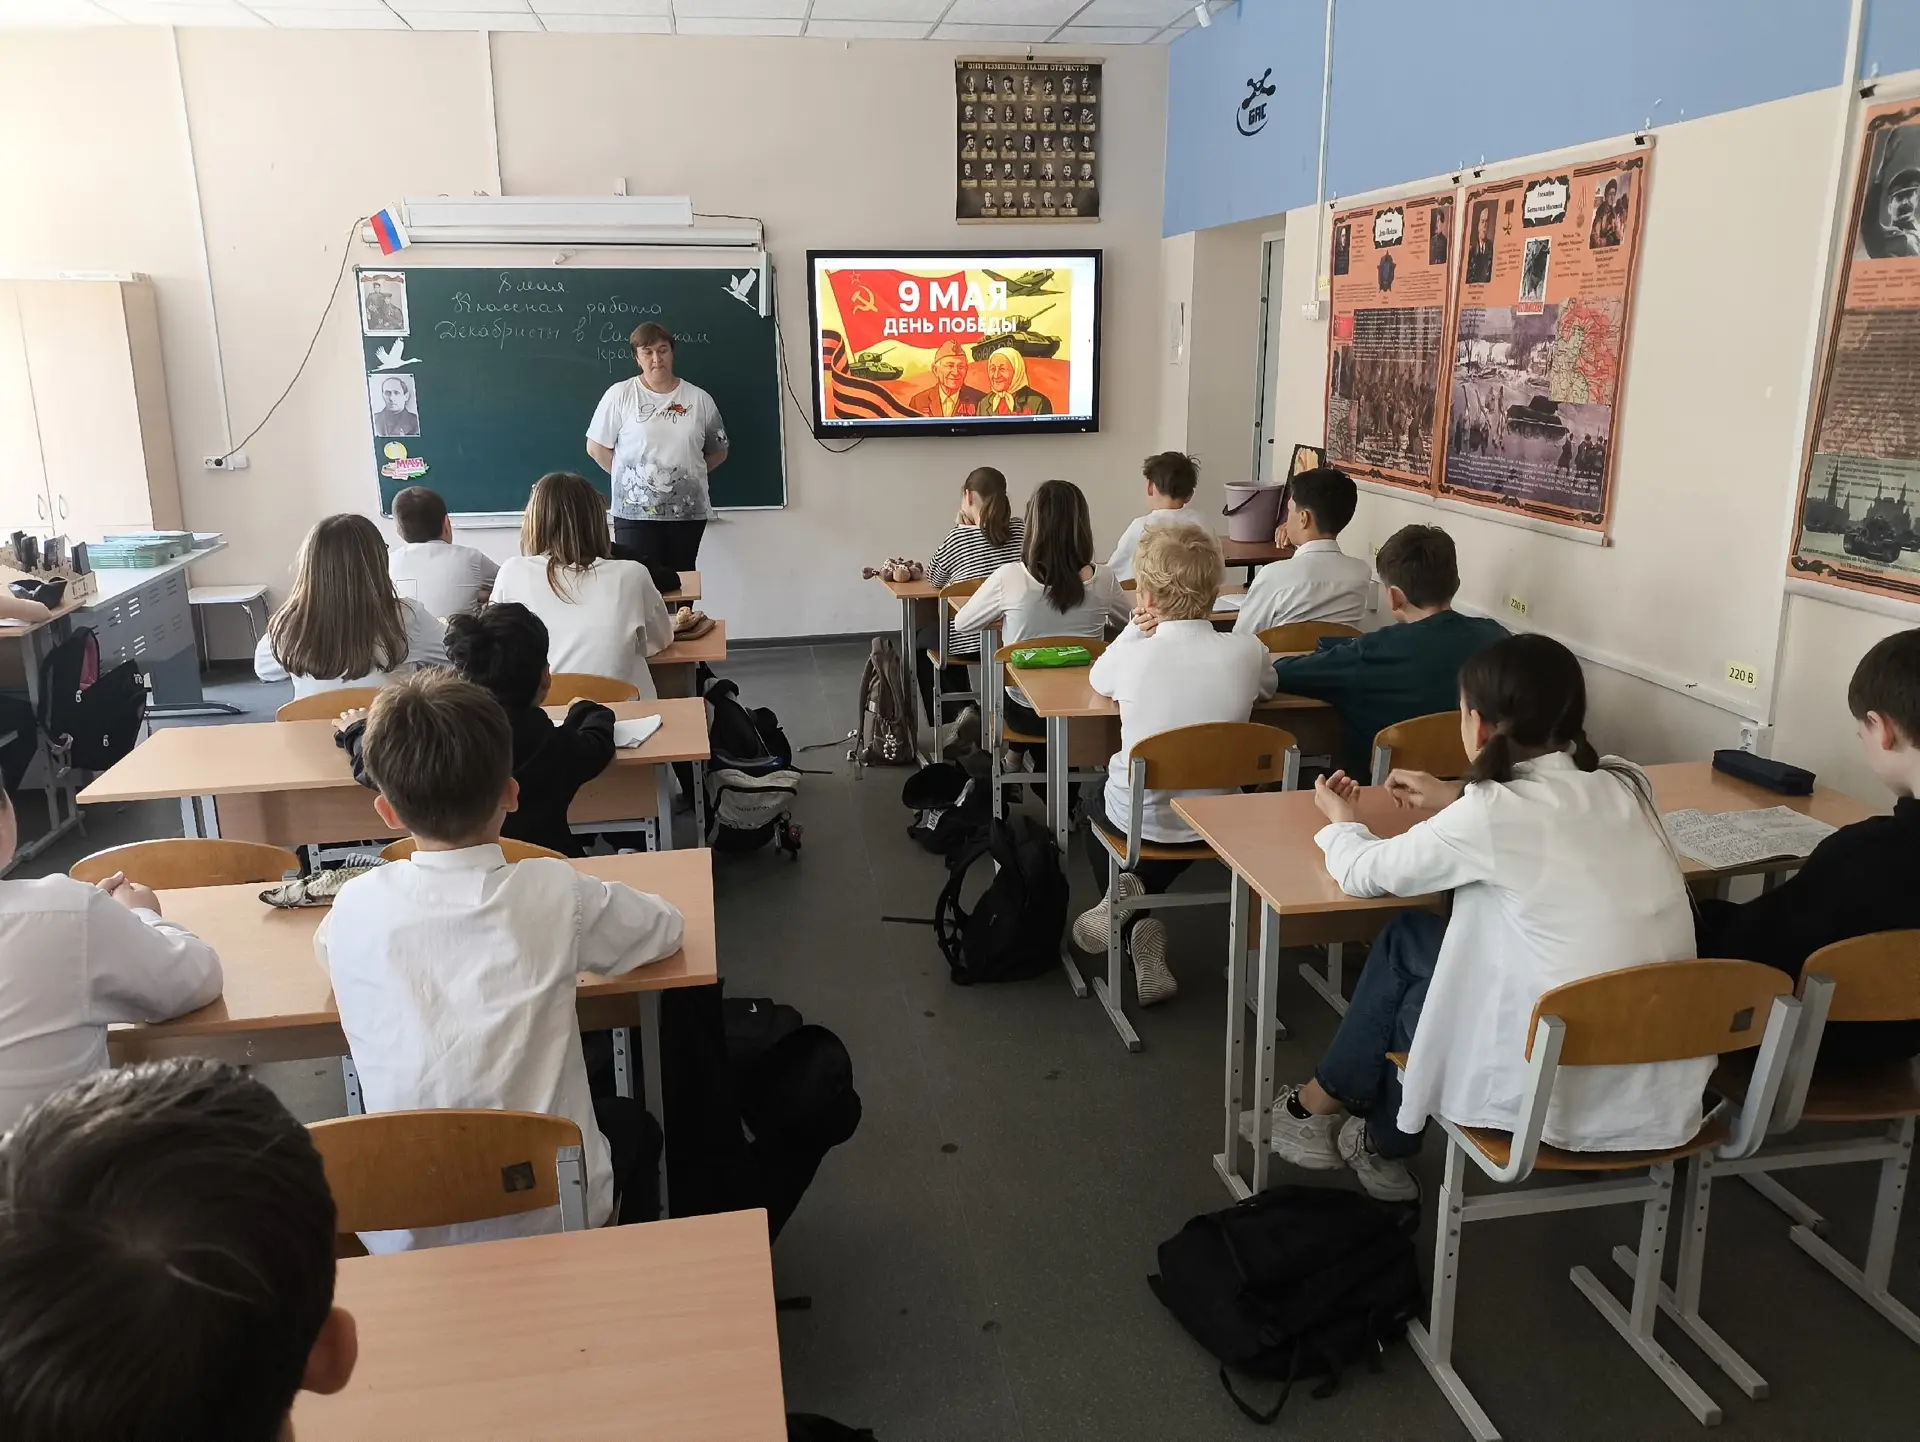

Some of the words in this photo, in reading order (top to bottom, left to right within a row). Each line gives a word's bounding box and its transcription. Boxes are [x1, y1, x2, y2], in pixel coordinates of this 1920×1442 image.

[1050, 64, 1090, 72] ОТЕЧЕСТВО
[897, 279, 921, 312] 9
[929, 280, 1007, 312] МАЯ
[451, 291, 564, 313] Классная
[586, 295, 663, 325] работа
[434, 317, 561, 350] Декабристы
[572, 316, 586, 343] в
[883, 317, 935, 337] ДЕНЬ
[938, 316, 1017, 336] ПОБЕДЫ
[597, 347, 634, 374] кра
[1510, 597, 1521, 611] 220
[1729, 667, 1746, 681] 220
[1747, 672, 1754, 684] В
